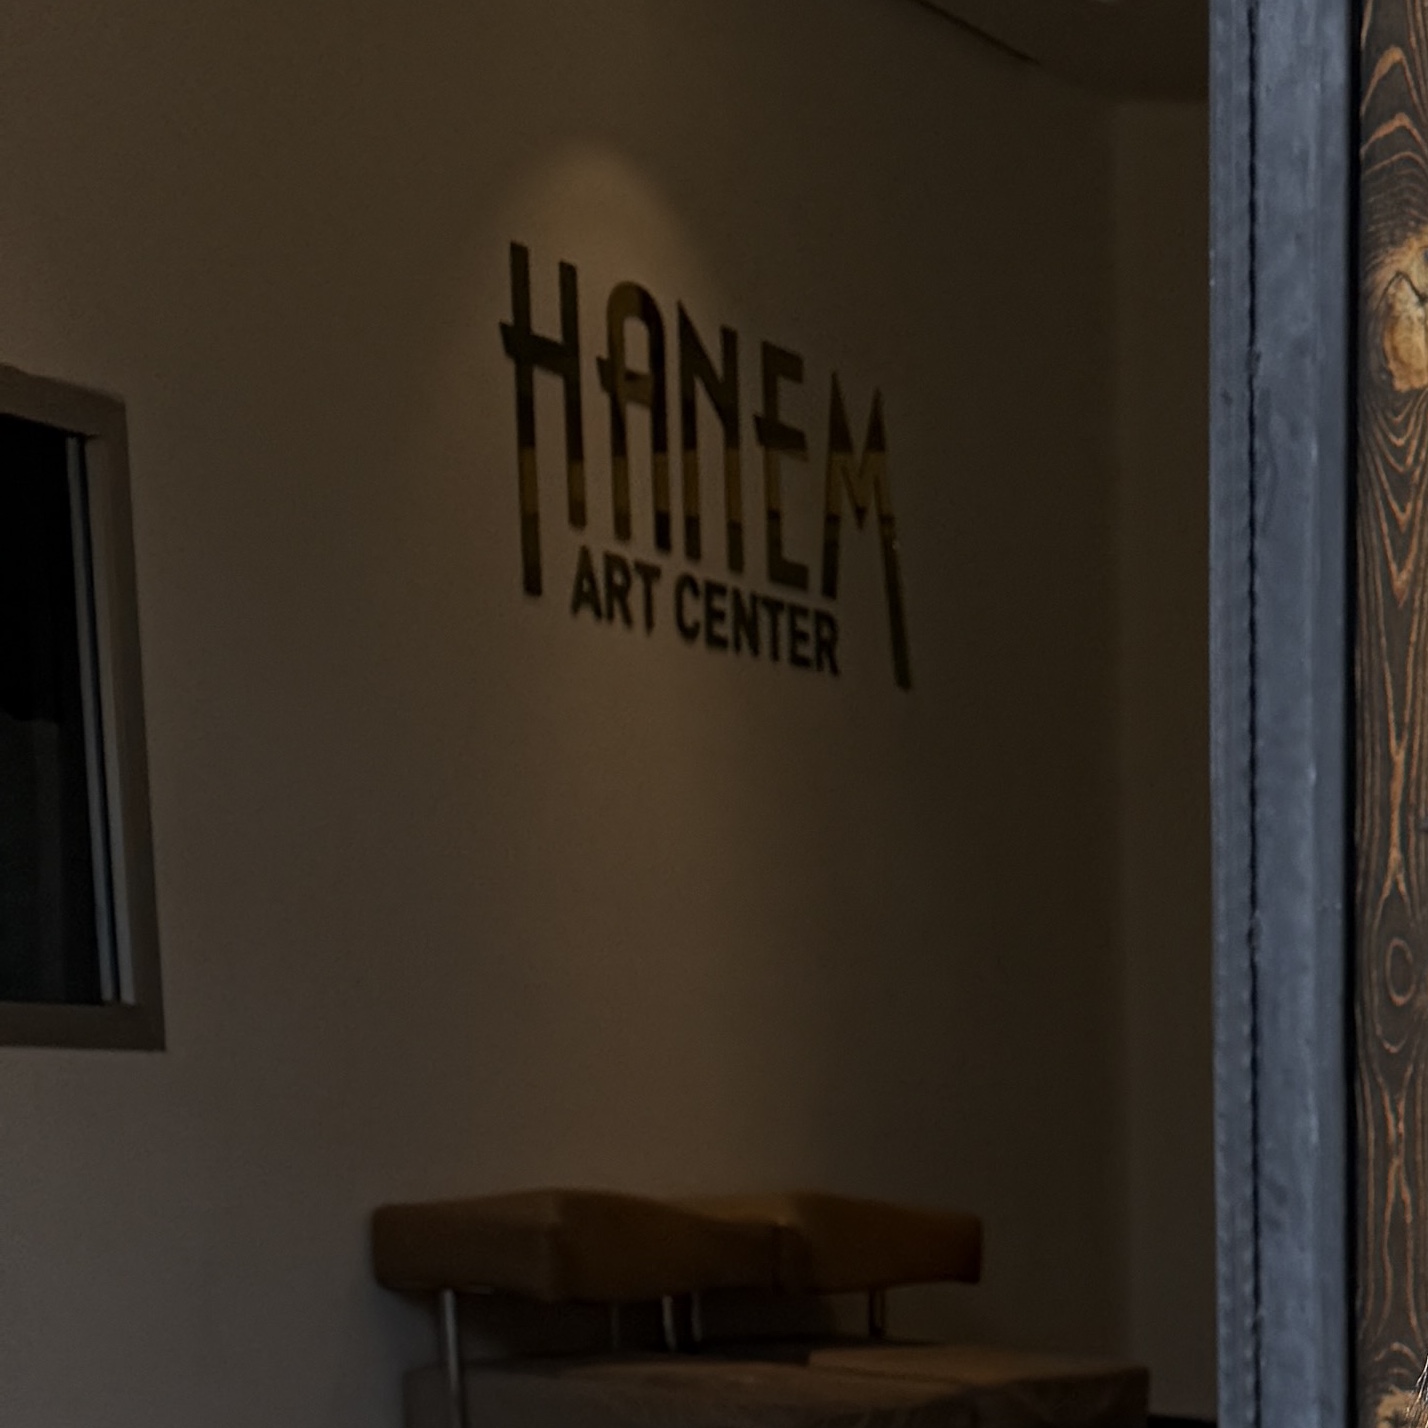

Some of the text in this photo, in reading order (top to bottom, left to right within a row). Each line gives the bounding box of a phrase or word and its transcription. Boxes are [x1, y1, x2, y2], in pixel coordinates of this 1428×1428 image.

[500, 242, 911, 690] HANEM
[571, 546, 839, 675] ART CENTER
